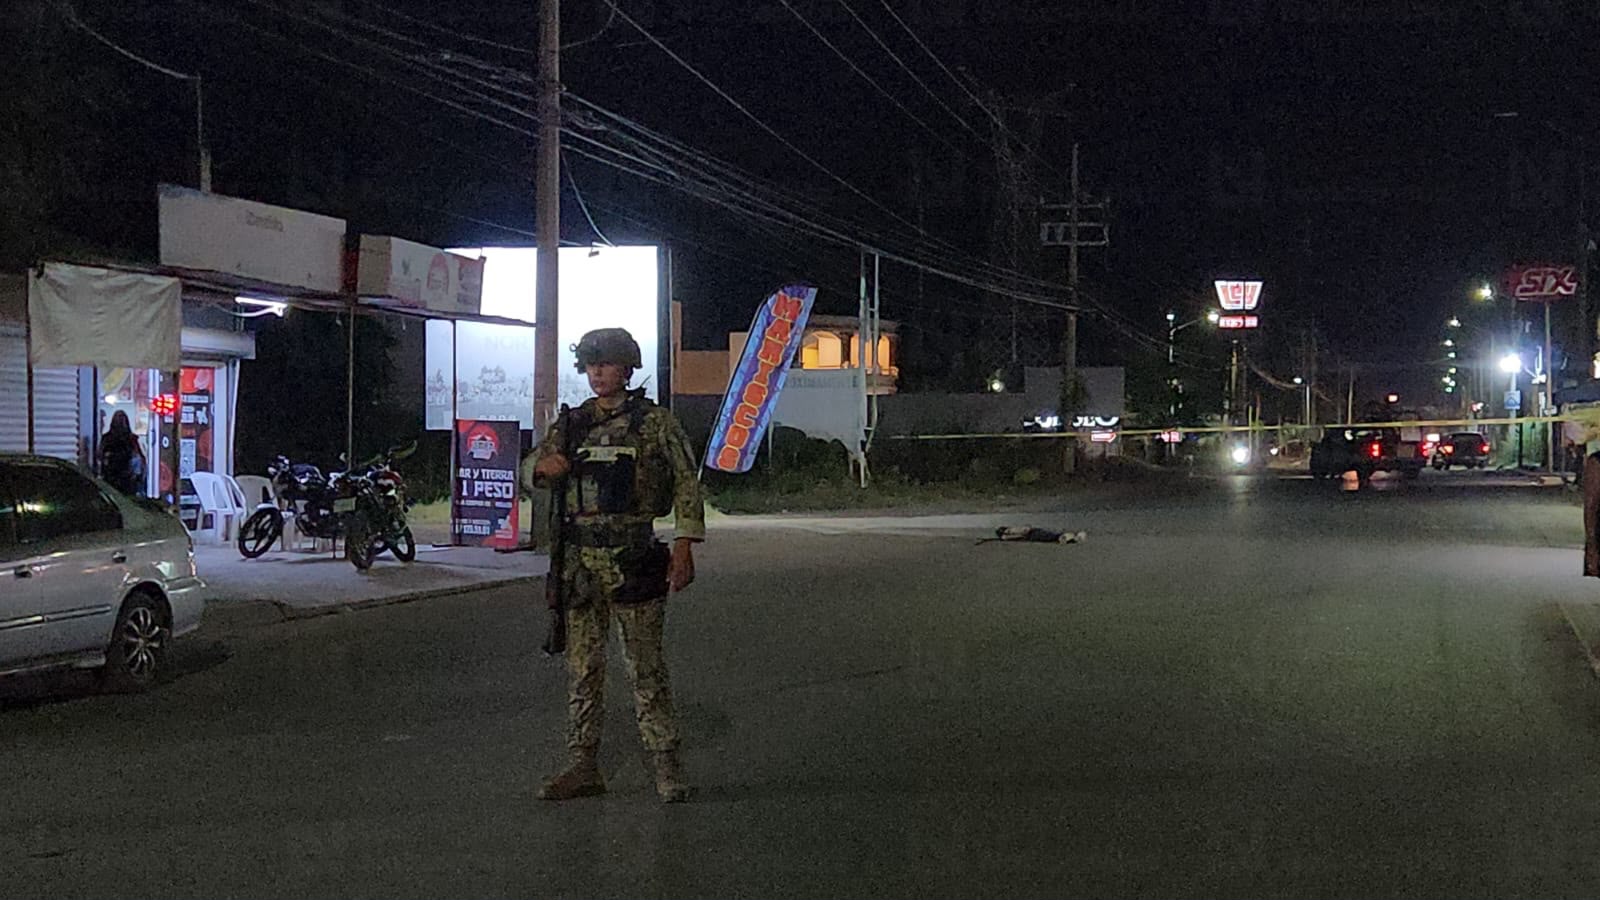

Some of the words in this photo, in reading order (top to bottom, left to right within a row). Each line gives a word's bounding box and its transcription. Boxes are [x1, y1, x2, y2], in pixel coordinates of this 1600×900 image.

[1515, 267, 1577, 296] SIX
[717, 290, 803, 471] MARISCOS
[473, 480, 514, 499] PESO
